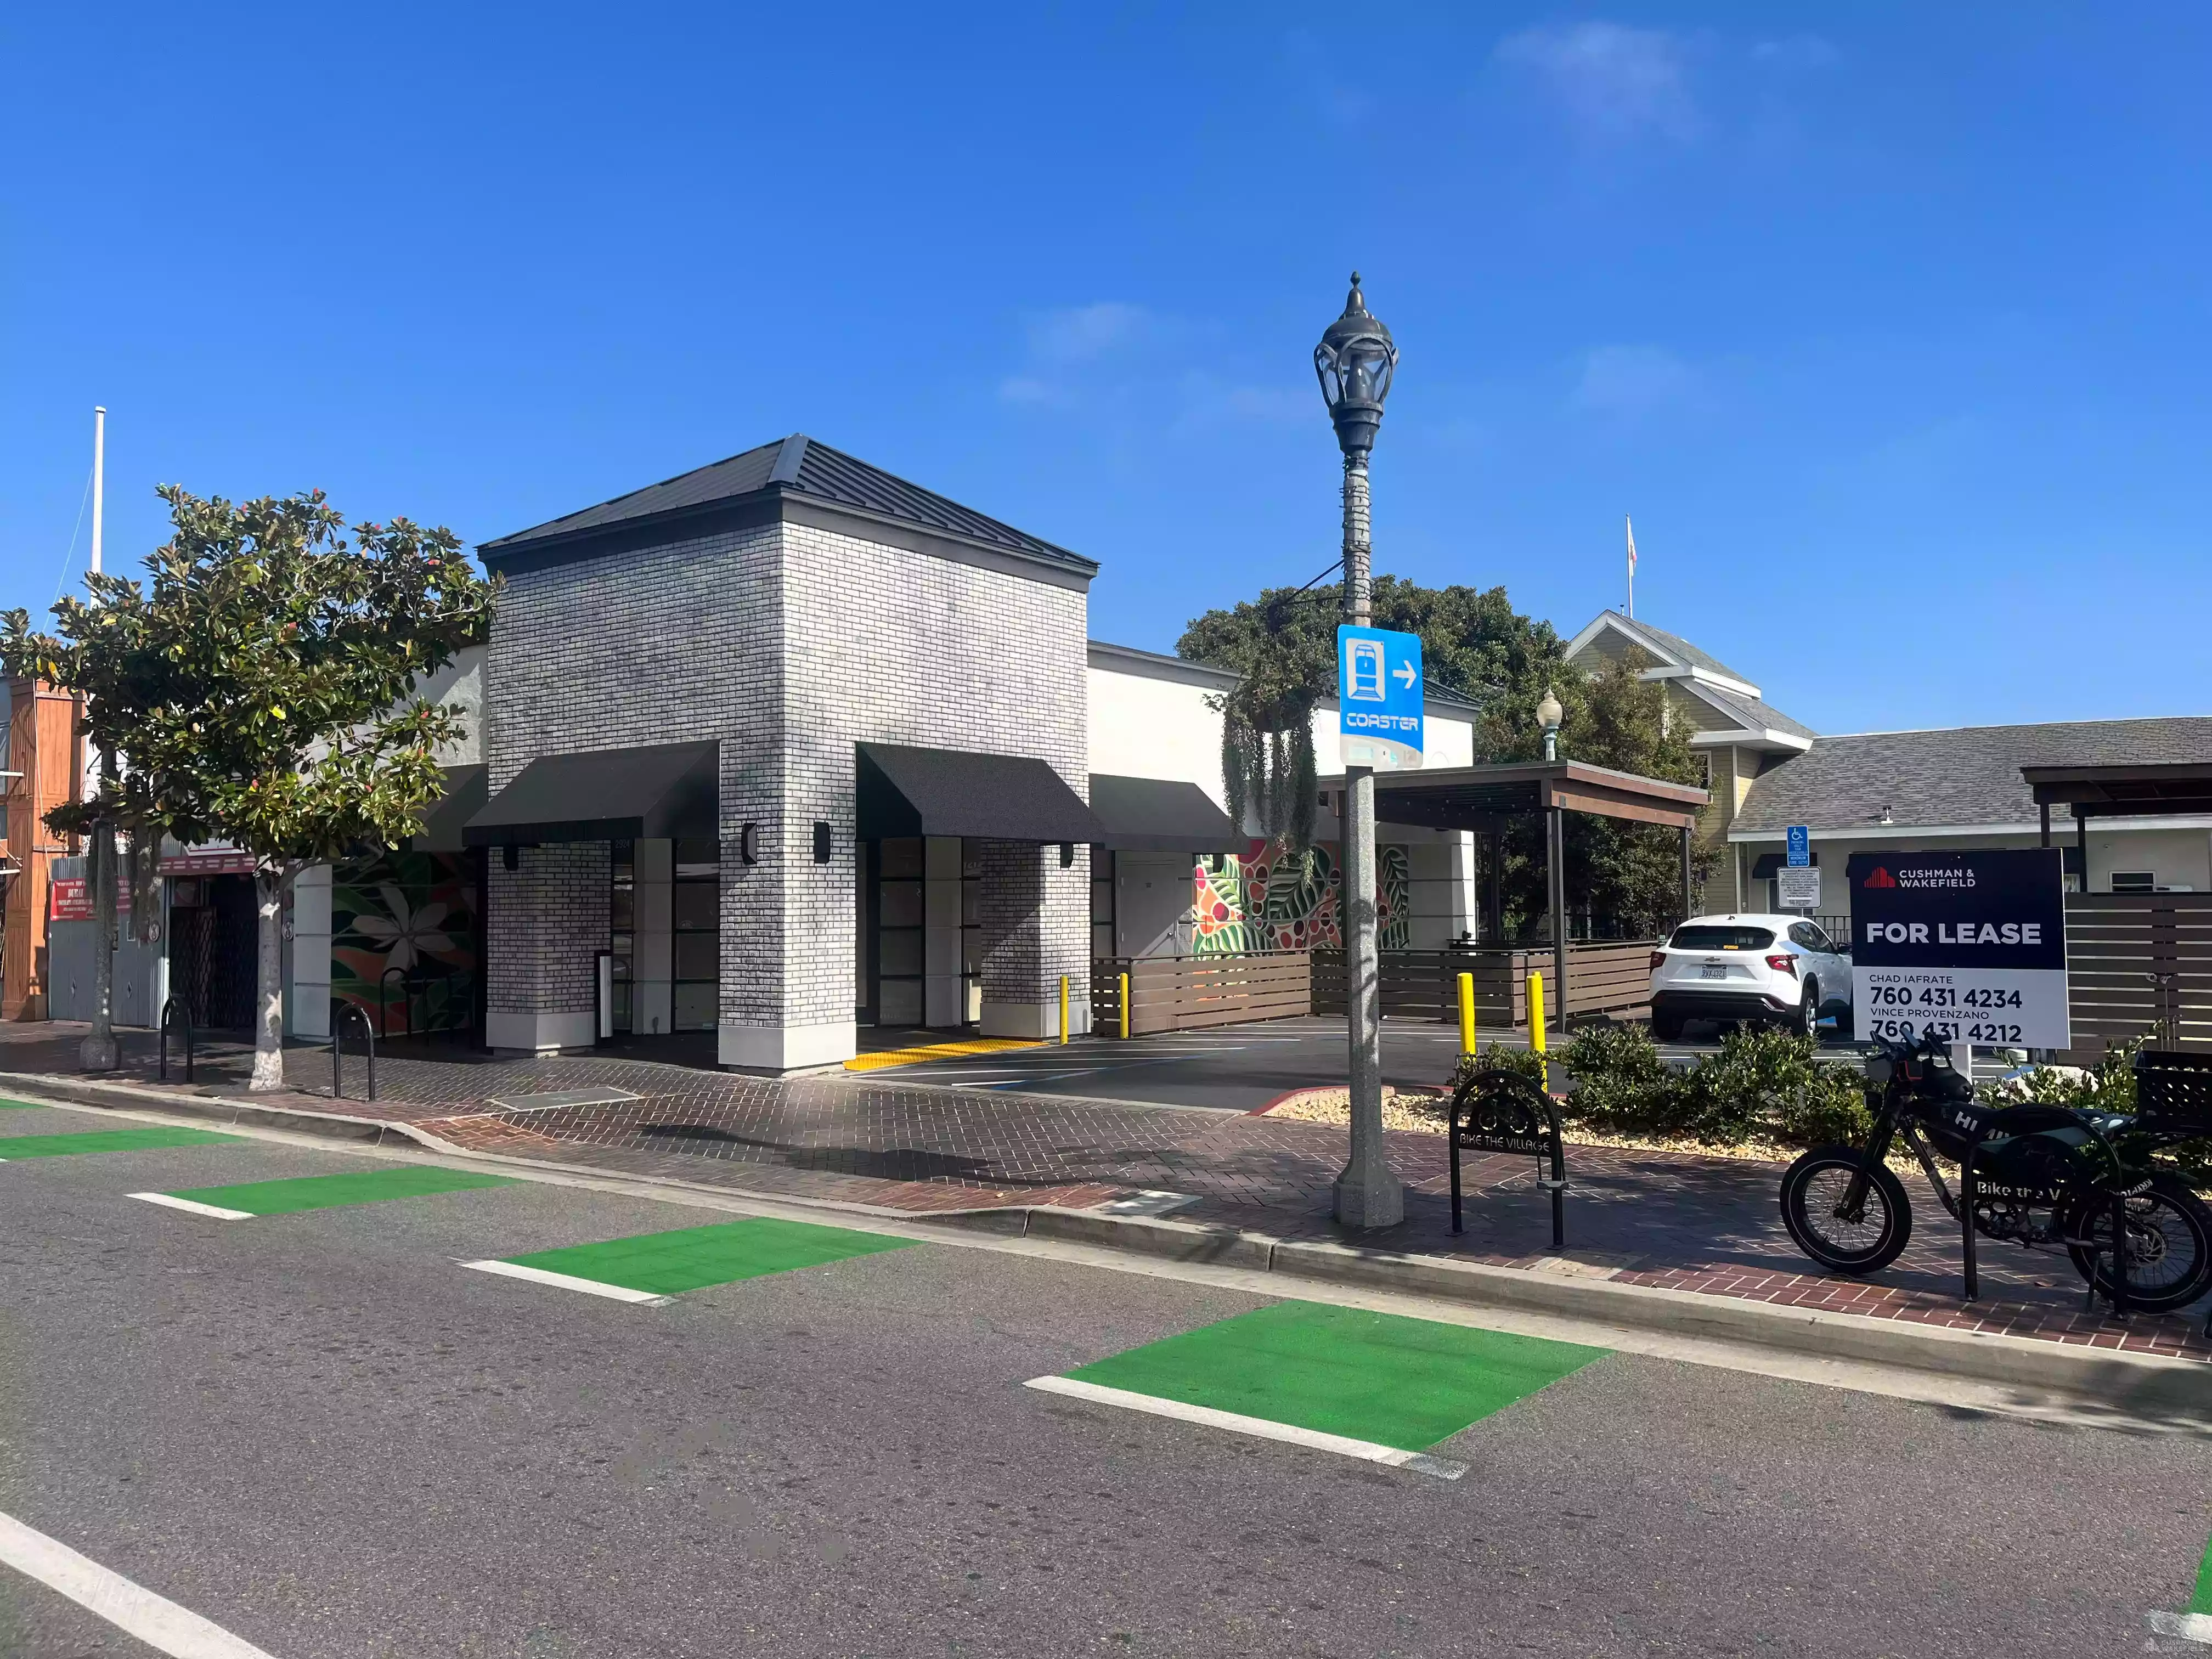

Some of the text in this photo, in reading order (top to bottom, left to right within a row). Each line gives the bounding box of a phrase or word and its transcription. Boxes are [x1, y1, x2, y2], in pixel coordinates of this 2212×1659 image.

[1346, 713, 1418, 731] COASTER
[1899, 869, 1974, 878] CUSHMAN &
[1899, 879, 1976, 888] WAKEFIELD
[1867, 923, 2041, 944] FOR LEASE
[1869, 974, 1953, 984] CHAD IAFRATE
[1870, 986, 2022, 1009] 760 431 4234
[1870, 1008, 1989, 1019] VINCE PROVENZANO
[1871, 1020, 2022, 1042] 760 431 4212
[1460, 1133, 1550, 1152] BIKE THE VILLAGE
[1977, 1181, 2011, 1196] Bike
